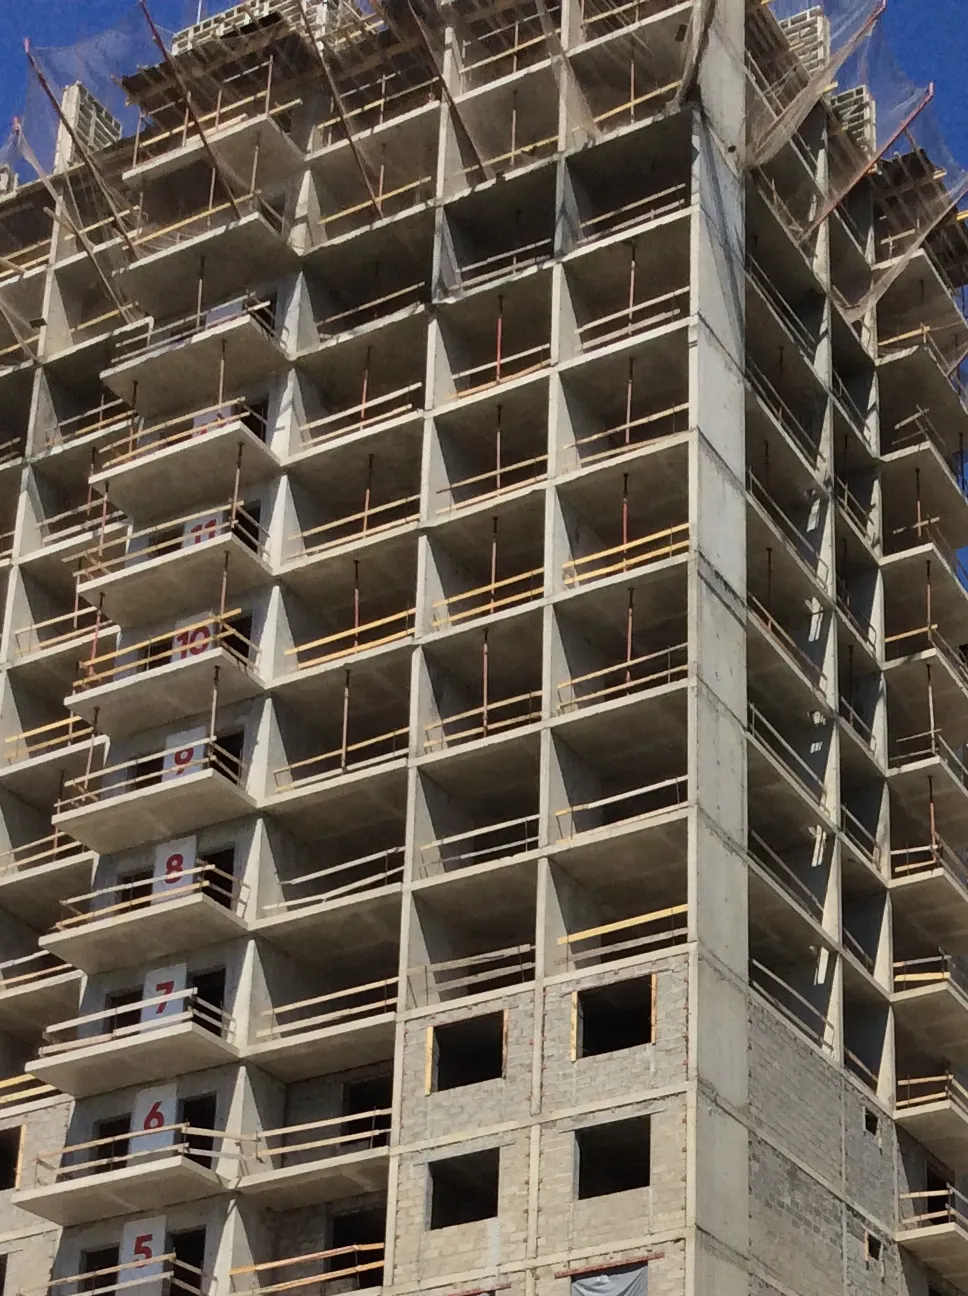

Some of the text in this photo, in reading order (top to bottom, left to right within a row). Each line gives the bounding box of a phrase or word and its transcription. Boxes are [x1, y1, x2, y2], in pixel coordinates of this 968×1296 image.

[177, 626, 211, 660] 10
[174, 747, 194, 776] 9
[164, 853, 184, 884] 8
[156, 980, 175, 1015] 7
[144, 1100, 165, 1133] 6
[131, 1233, 153, 1269] 5
